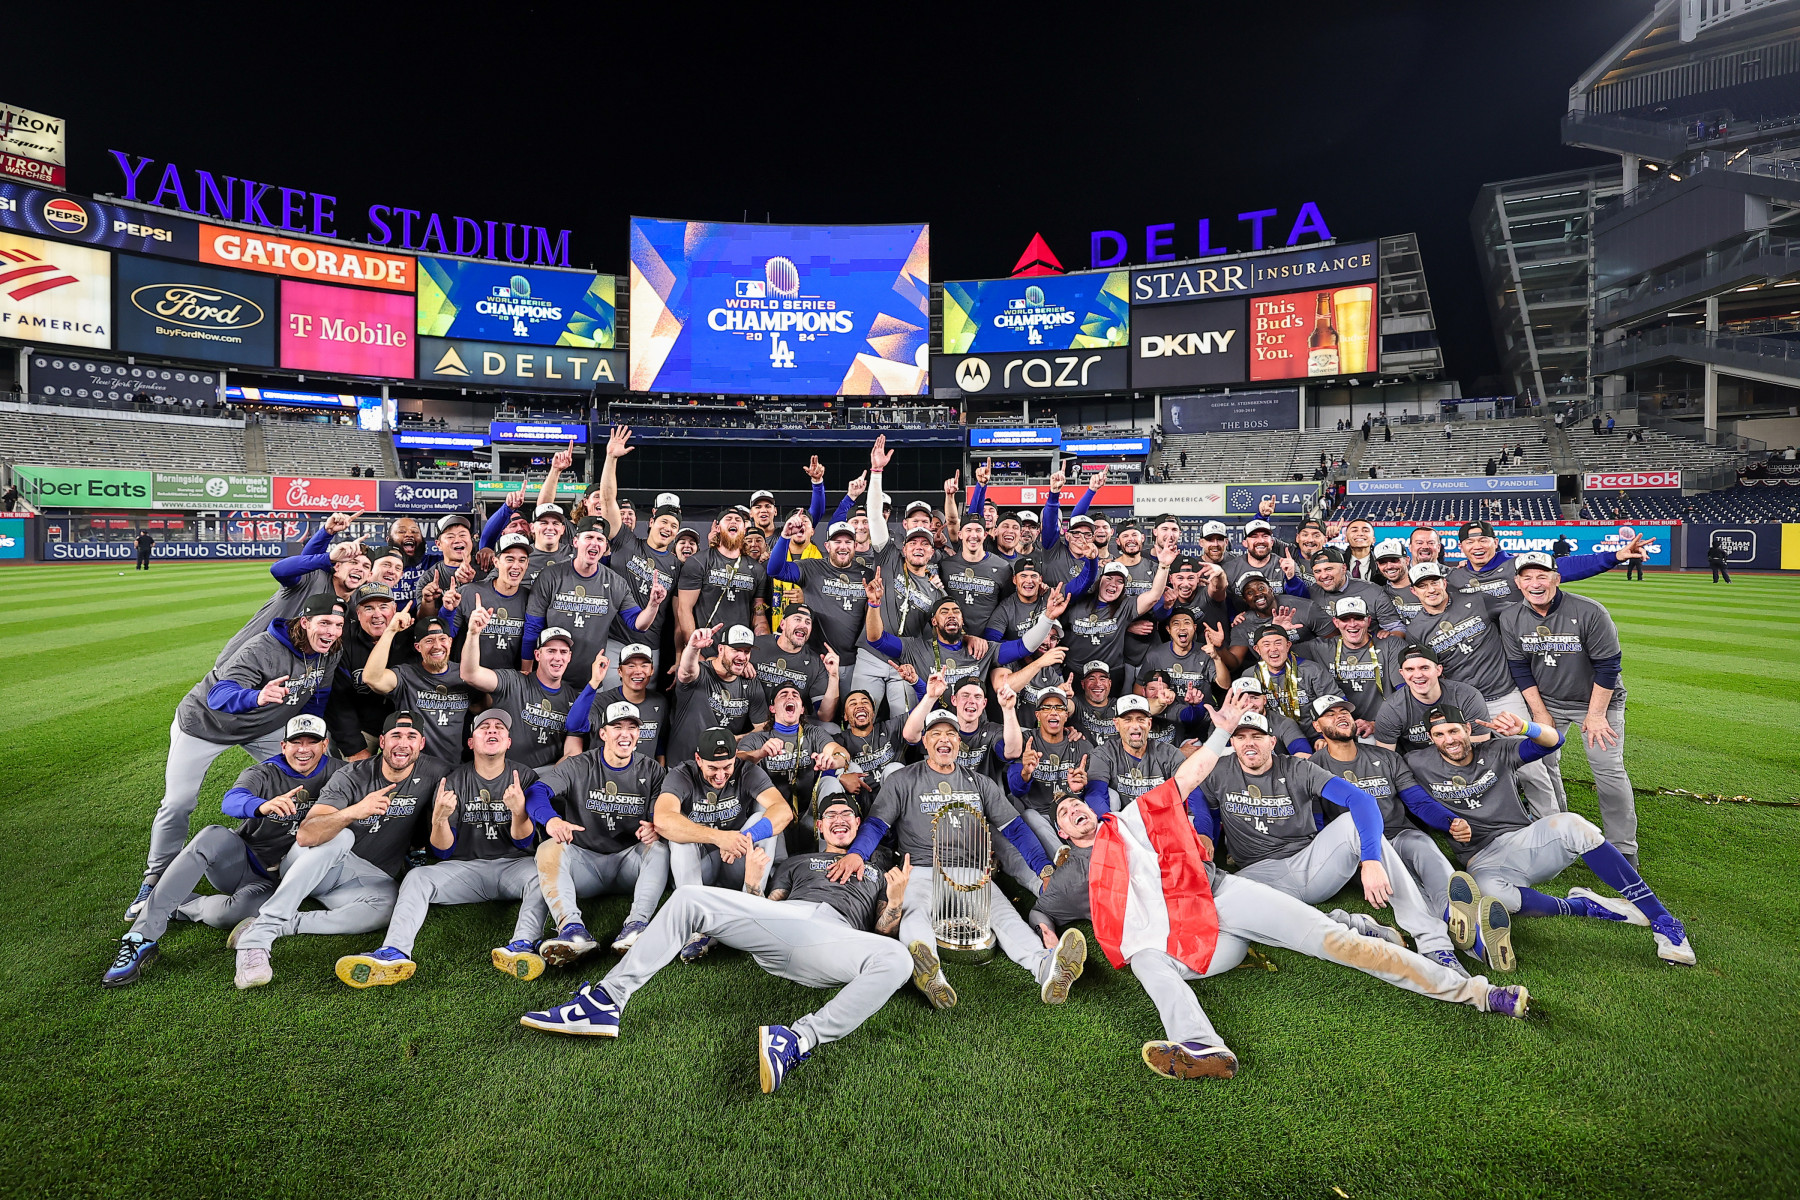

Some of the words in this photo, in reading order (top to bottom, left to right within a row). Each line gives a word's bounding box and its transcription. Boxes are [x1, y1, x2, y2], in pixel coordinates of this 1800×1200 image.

[5, 165, 52, 182] WATCHES
[108, 149, 337, 238] YANKEE
[367, 204, 572, 267] STADIUM
[47, 208, 85, 224] PEPSI
[113, 220, 173, 242] PEPSI
[1091, 201, 1333, 268] DELTA
[214, 234, 407, 284] GATORADE
[1135, 265, 1248, 300] STARR
[1257, 253, 1372, 281] INSURANCE
[156, 288, 243, 325] Ford
[486, 296, 518, 305] WORLD
[520, 298, 552, 307] SERIES
[725, 298, 779, 310] WORLD
[782, 299, 836, 310] SERIES
[1255, 300, 1295, 316] This
[475, 300, 563, 320] CHAMPIONS
[17, 313, 105, 335] AMERICA
[707, 307, 854, 333] CHAMPIONS
[993, 310, 1076, 328] CHAMPIONS
[1255, 313, 1304, 331] Bud's
[155, 326, 242, 344] BuyFordNow.com
[289, 313, 312, 338] T
[320, 317, 407, 347] Mobile
[1140, 329, 1237, 359] DKNY
[1255, 332, 1286, 346] For
[745, 332, 763, 341] 20
[769, 332, 796, 368] LA
[798, 333, 816, 342] 24
[1255, 347, 1294, 361] You.
[483, 351, 615, 382] DELTA
[1003, 355, 1102, 389] razr
[1221, 421, 1241, 429] THE
[1243, 420, 1269, 428] BOSS
[156, 474, 204, 485] Morningside
[478, 481, 504, 489] bet365
[1587, 474, 1679, 489] Reebok
[88, 480, 147, 498] Eats
[245, 485, 268, 493] Circle
[415, 487, 458, 502] coupa
[53, 544, 131, 558] StubHub
[152, 543, 209, 557] tubHub
[216, 543, 281, 557] StubHub
[823, 578, 848, 588] WORLD
[947, 581, 994, 594] CHAMPIONS
[949, 574, 971, 582] WORLD
[971, 577, 994, 587] SERIES
[555, 593, 583, 603] WORLD
[583, 596, 609, 605] SERIES
[552, 601, 608, 615] CHAMPIONS
[1427, 630, 1456, 648] WORLD
[1454, 615, 1482, 635] SERIES
[1432, 622, 1487, 655] CHAMPIONS
[1549, 635, 1580, 643] SERIES
[1521, 643, 1583, 652] CHAMPIONS
[757, 663, 783, 676] WORLD
[783, 669, 808, 681] SERIES
[416, 691, 447, 700] WORLD
[1359, 778, 1389, 787] SERIES
[616, 795, 645, 805] SERIES
[716, 798, 740, 810] SERIES
[919, 794, 951, 803] WORLD
[951, 792, 980, 800] SERIES
[1226, 793, 1261, 806] WORLD
[1261, 797, 1293, 807] SERIES
[1225, 801, 1295, 817] CHAMPIONS
[1254, 817, 1269, 835] LA
